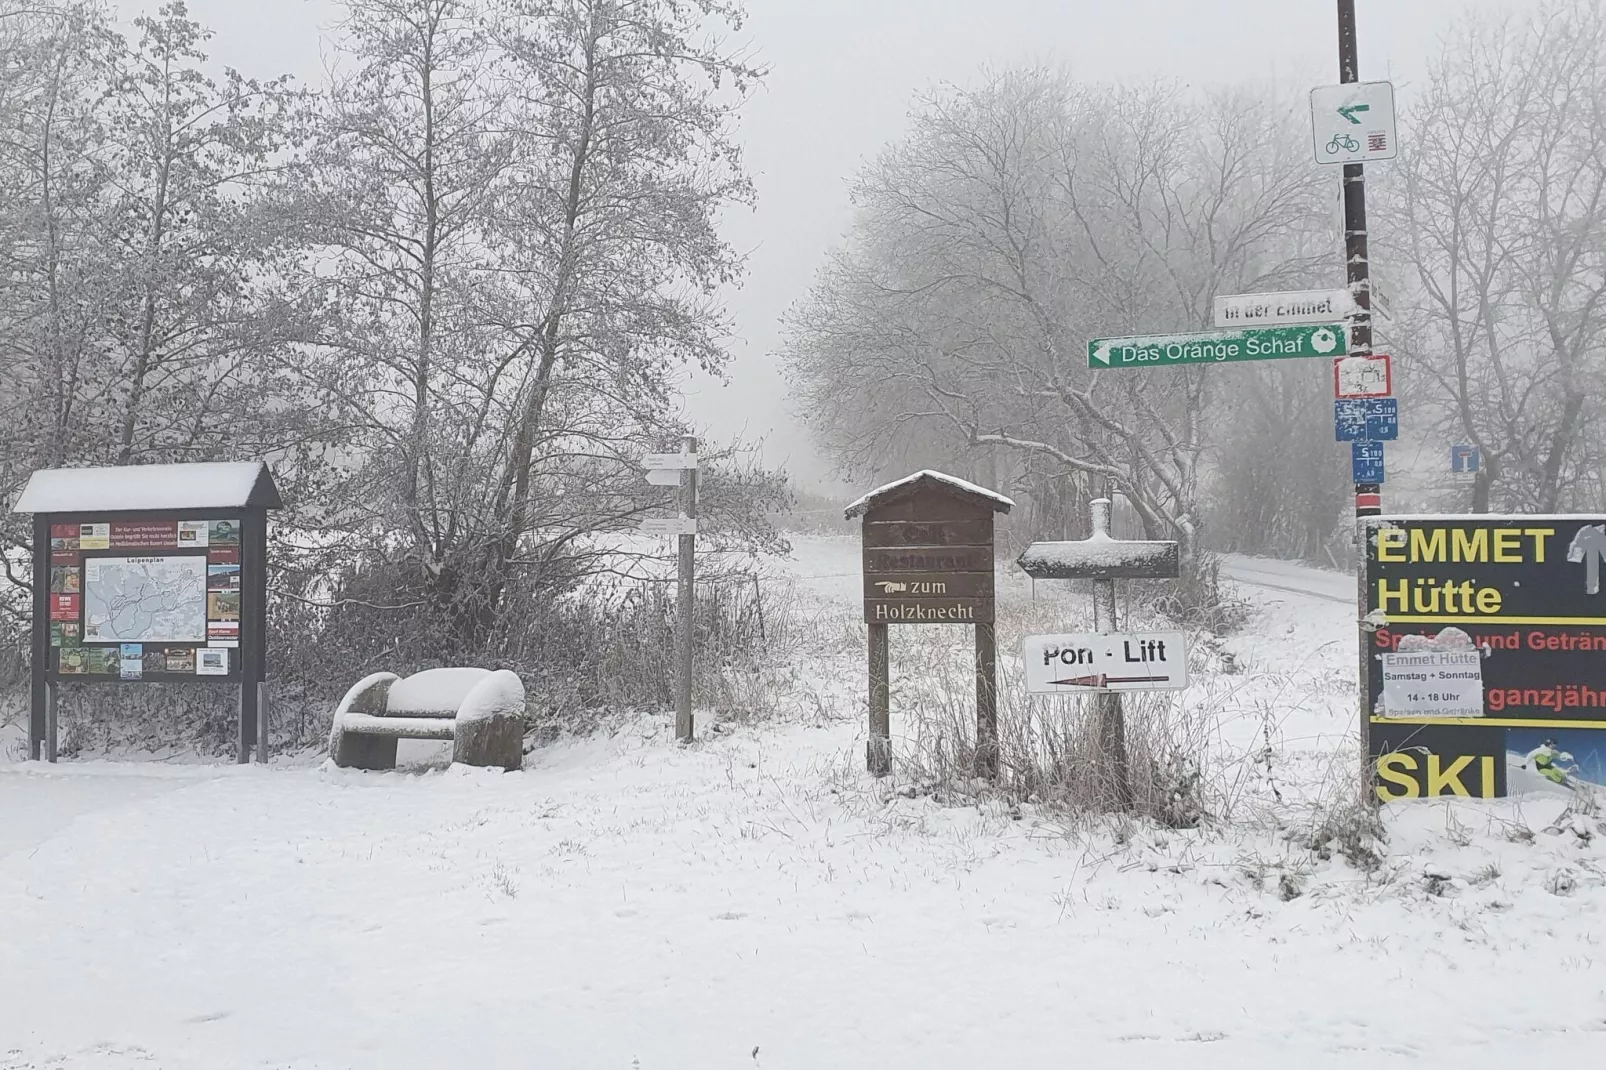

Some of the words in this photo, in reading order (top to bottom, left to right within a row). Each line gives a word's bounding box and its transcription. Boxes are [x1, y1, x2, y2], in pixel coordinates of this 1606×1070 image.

[1121, 346, 1160, 363] Das
[1166, 342, 1239, 361] Orange
[1245, 337, 1304, 356] Schaf
[1377, 528, 1555, 563] EMMET
[910, 581, 947, 594] zum
[1377, 578, 1503, 614] Hütte
[875, 603, 974, 620] Holzknecht
[1475, 631, 1520, 649] und
[1123, 639, 1167, 663] Lift
[1386, 654, 1436, 666] Emmet
[1440, 652, 1478, 665] Hütte
[1384, 672, 1427, 682] Samstag
[1438, 671, 1480, 681] Sonntag
[1407, 693, 1419, 702] 14
[1427, 693, 1439, 702] 18
[1441, 692, 1461, 702] Uhr
[1388, 708, 1422, 717] Speisen
[1375, 753, 1495, 802] SKI
